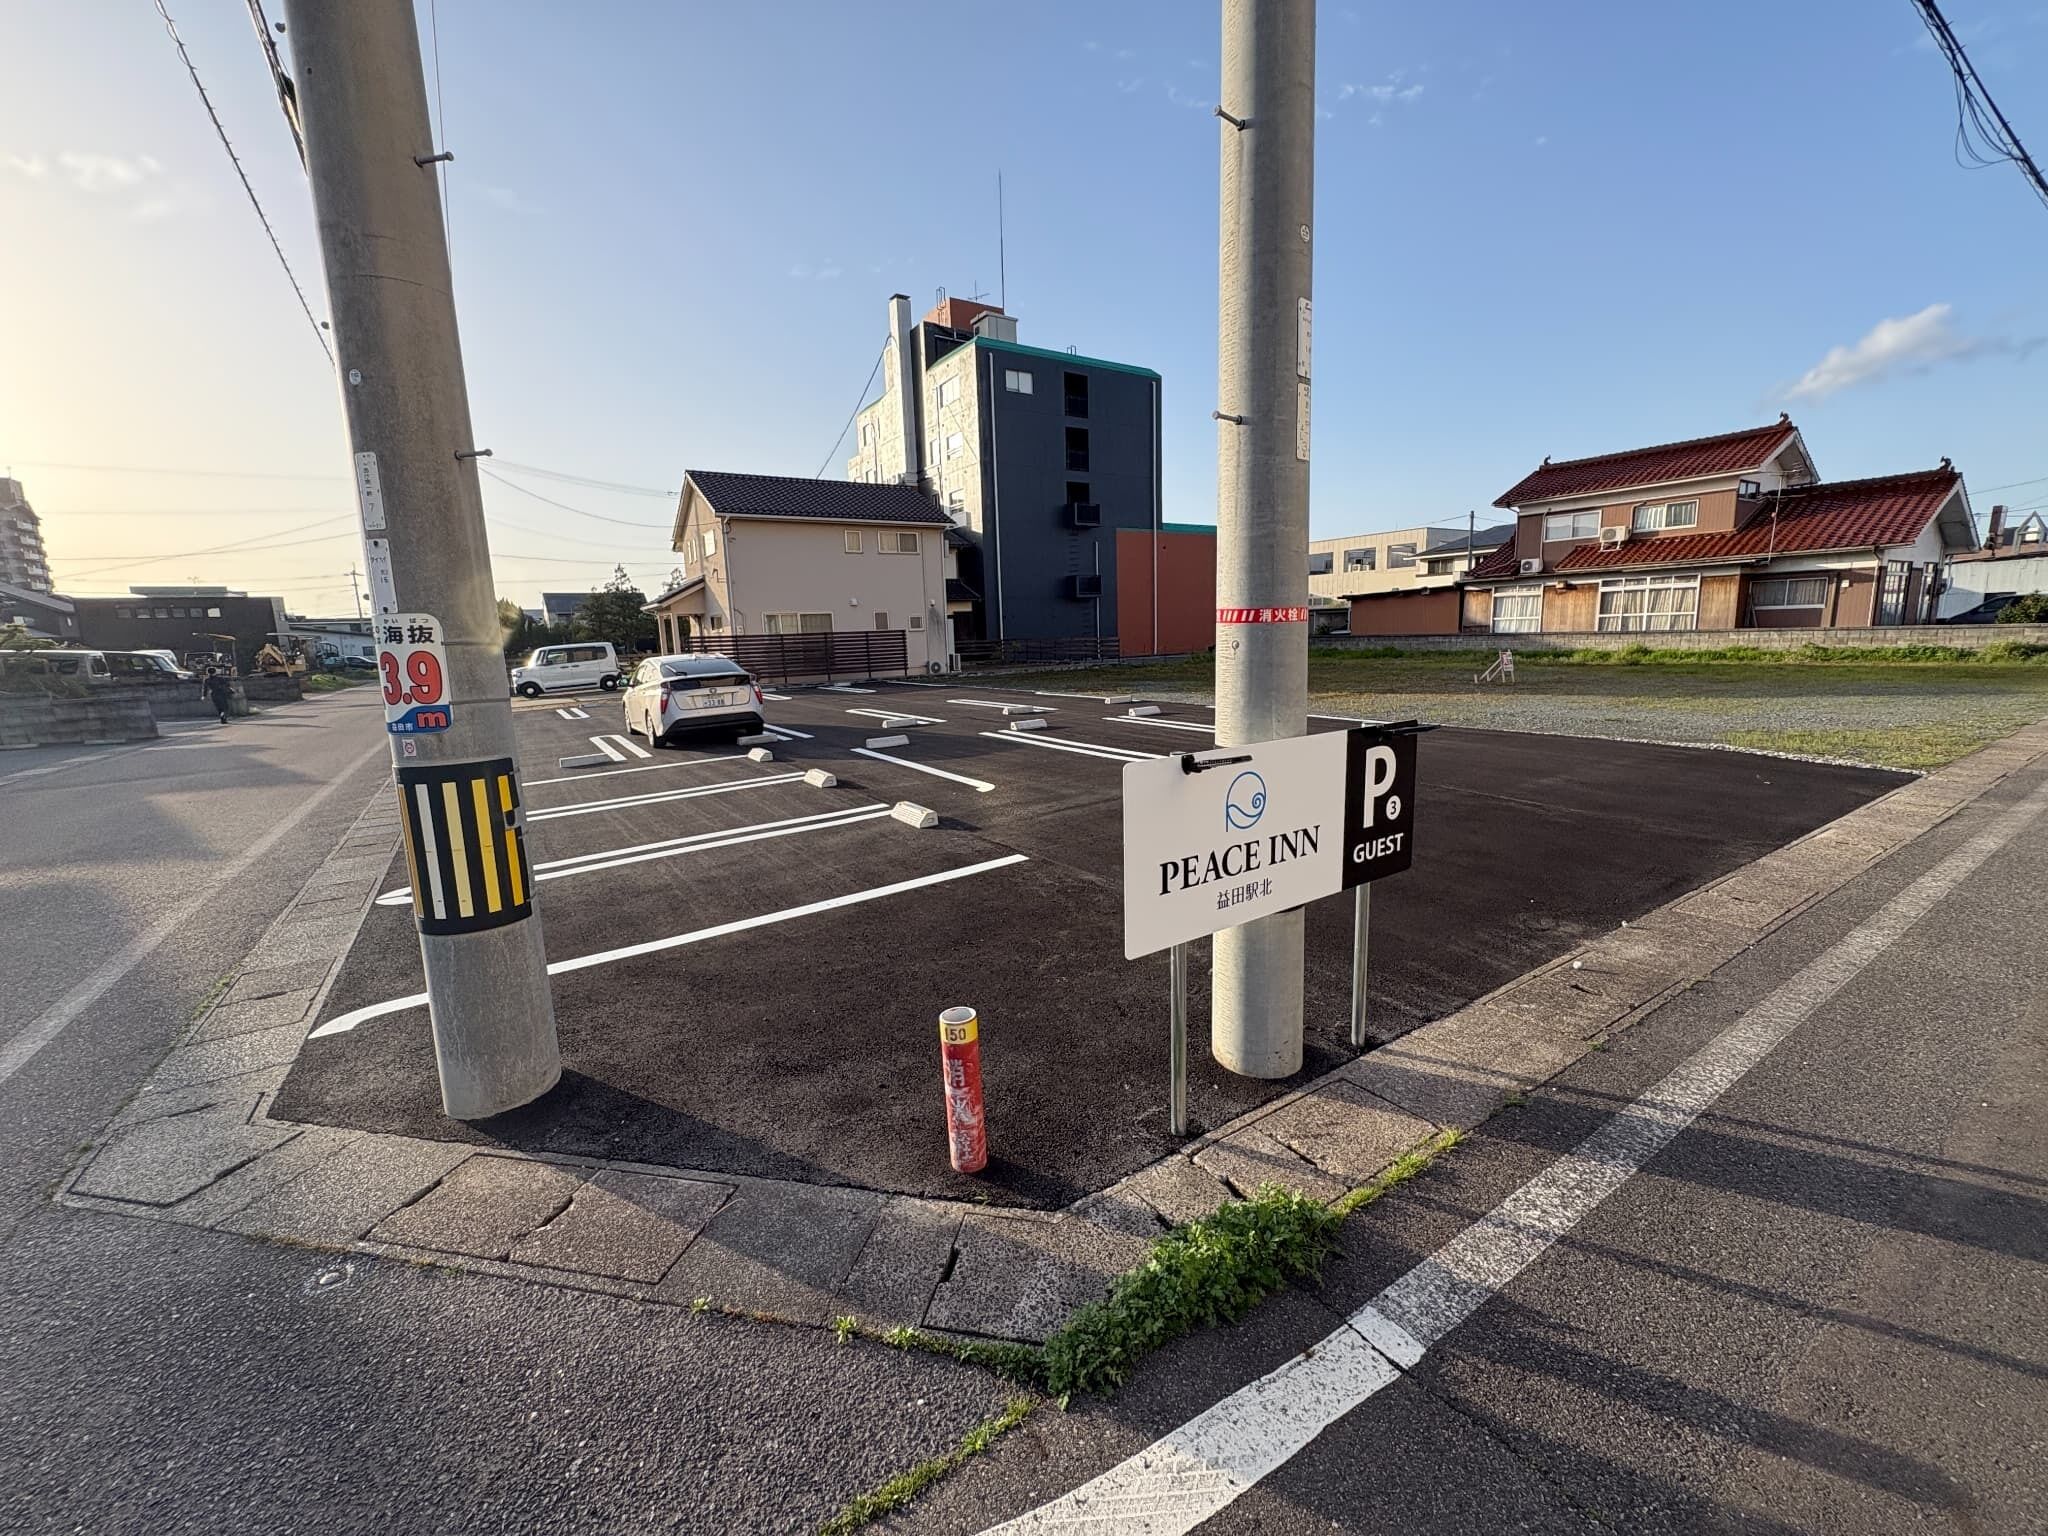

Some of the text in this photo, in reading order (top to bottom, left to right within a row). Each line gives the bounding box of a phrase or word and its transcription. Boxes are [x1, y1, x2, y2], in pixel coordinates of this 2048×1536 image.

[1259, 608, 1298, 622] 消火栓
[383, 625, 435, 644] 海抜
[380, 651, 443, 705] 3.9
[416, 711, 448, 728] m
[1363, 745, 1397, 829] P
[1159, 825, 1321, 895] PEACE INN
[1352, 832, 1404, 864] GUEST
[1216, 877, 1273, 910] 益田駅北
